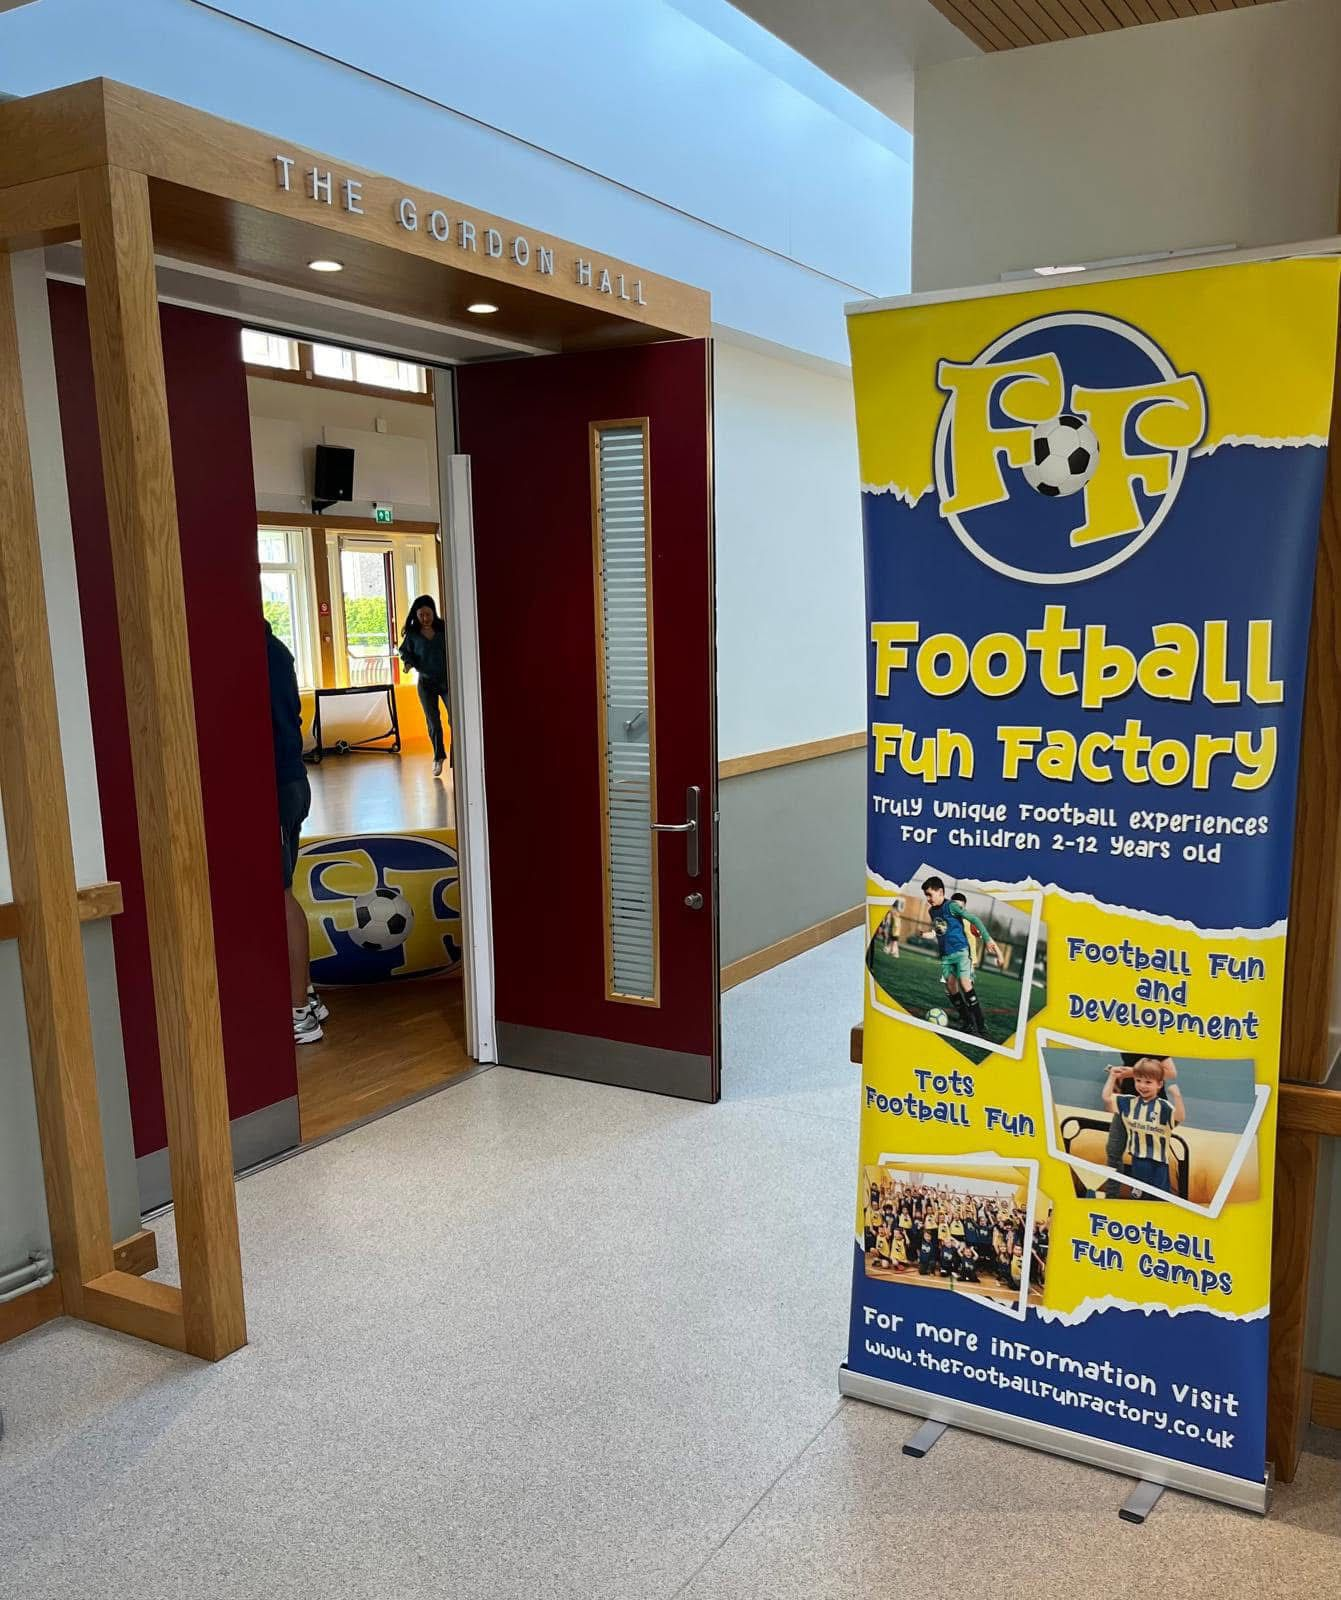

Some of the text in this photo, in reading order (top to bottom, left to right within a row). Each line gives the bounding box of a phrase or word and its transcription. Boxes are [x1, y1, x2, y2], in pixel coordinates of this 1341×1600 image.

[273, 154, 647, 306] THE GORDON HALL
[871, 604, 1284, 709] Football
[872, 719, 1278, 790] Fun Factory
[873, 795, 922, 817] Truly
[1019, 803, 1117, 827] Football
[1130, 809, 1269, 836] experiences
[1052, 834, 1098, 854] 2-12
[1183, 842, 1221, 864] old
[1067, 937, 1265, 983] Football Fun
[1136, 977, 1187, 1006] and
[1068, 994, 1259, 1040] Development
[914, 1069, 974, 1097] Tots
[866, 1085, 1035, 1137] Football Fun
[1089, 1212, 1215, 1263] Football
[1072, 1238, 1233, 1296] Fun Camps
[862, 1306, 904, 1332] For
[915, 1321, 978, 1351] more
